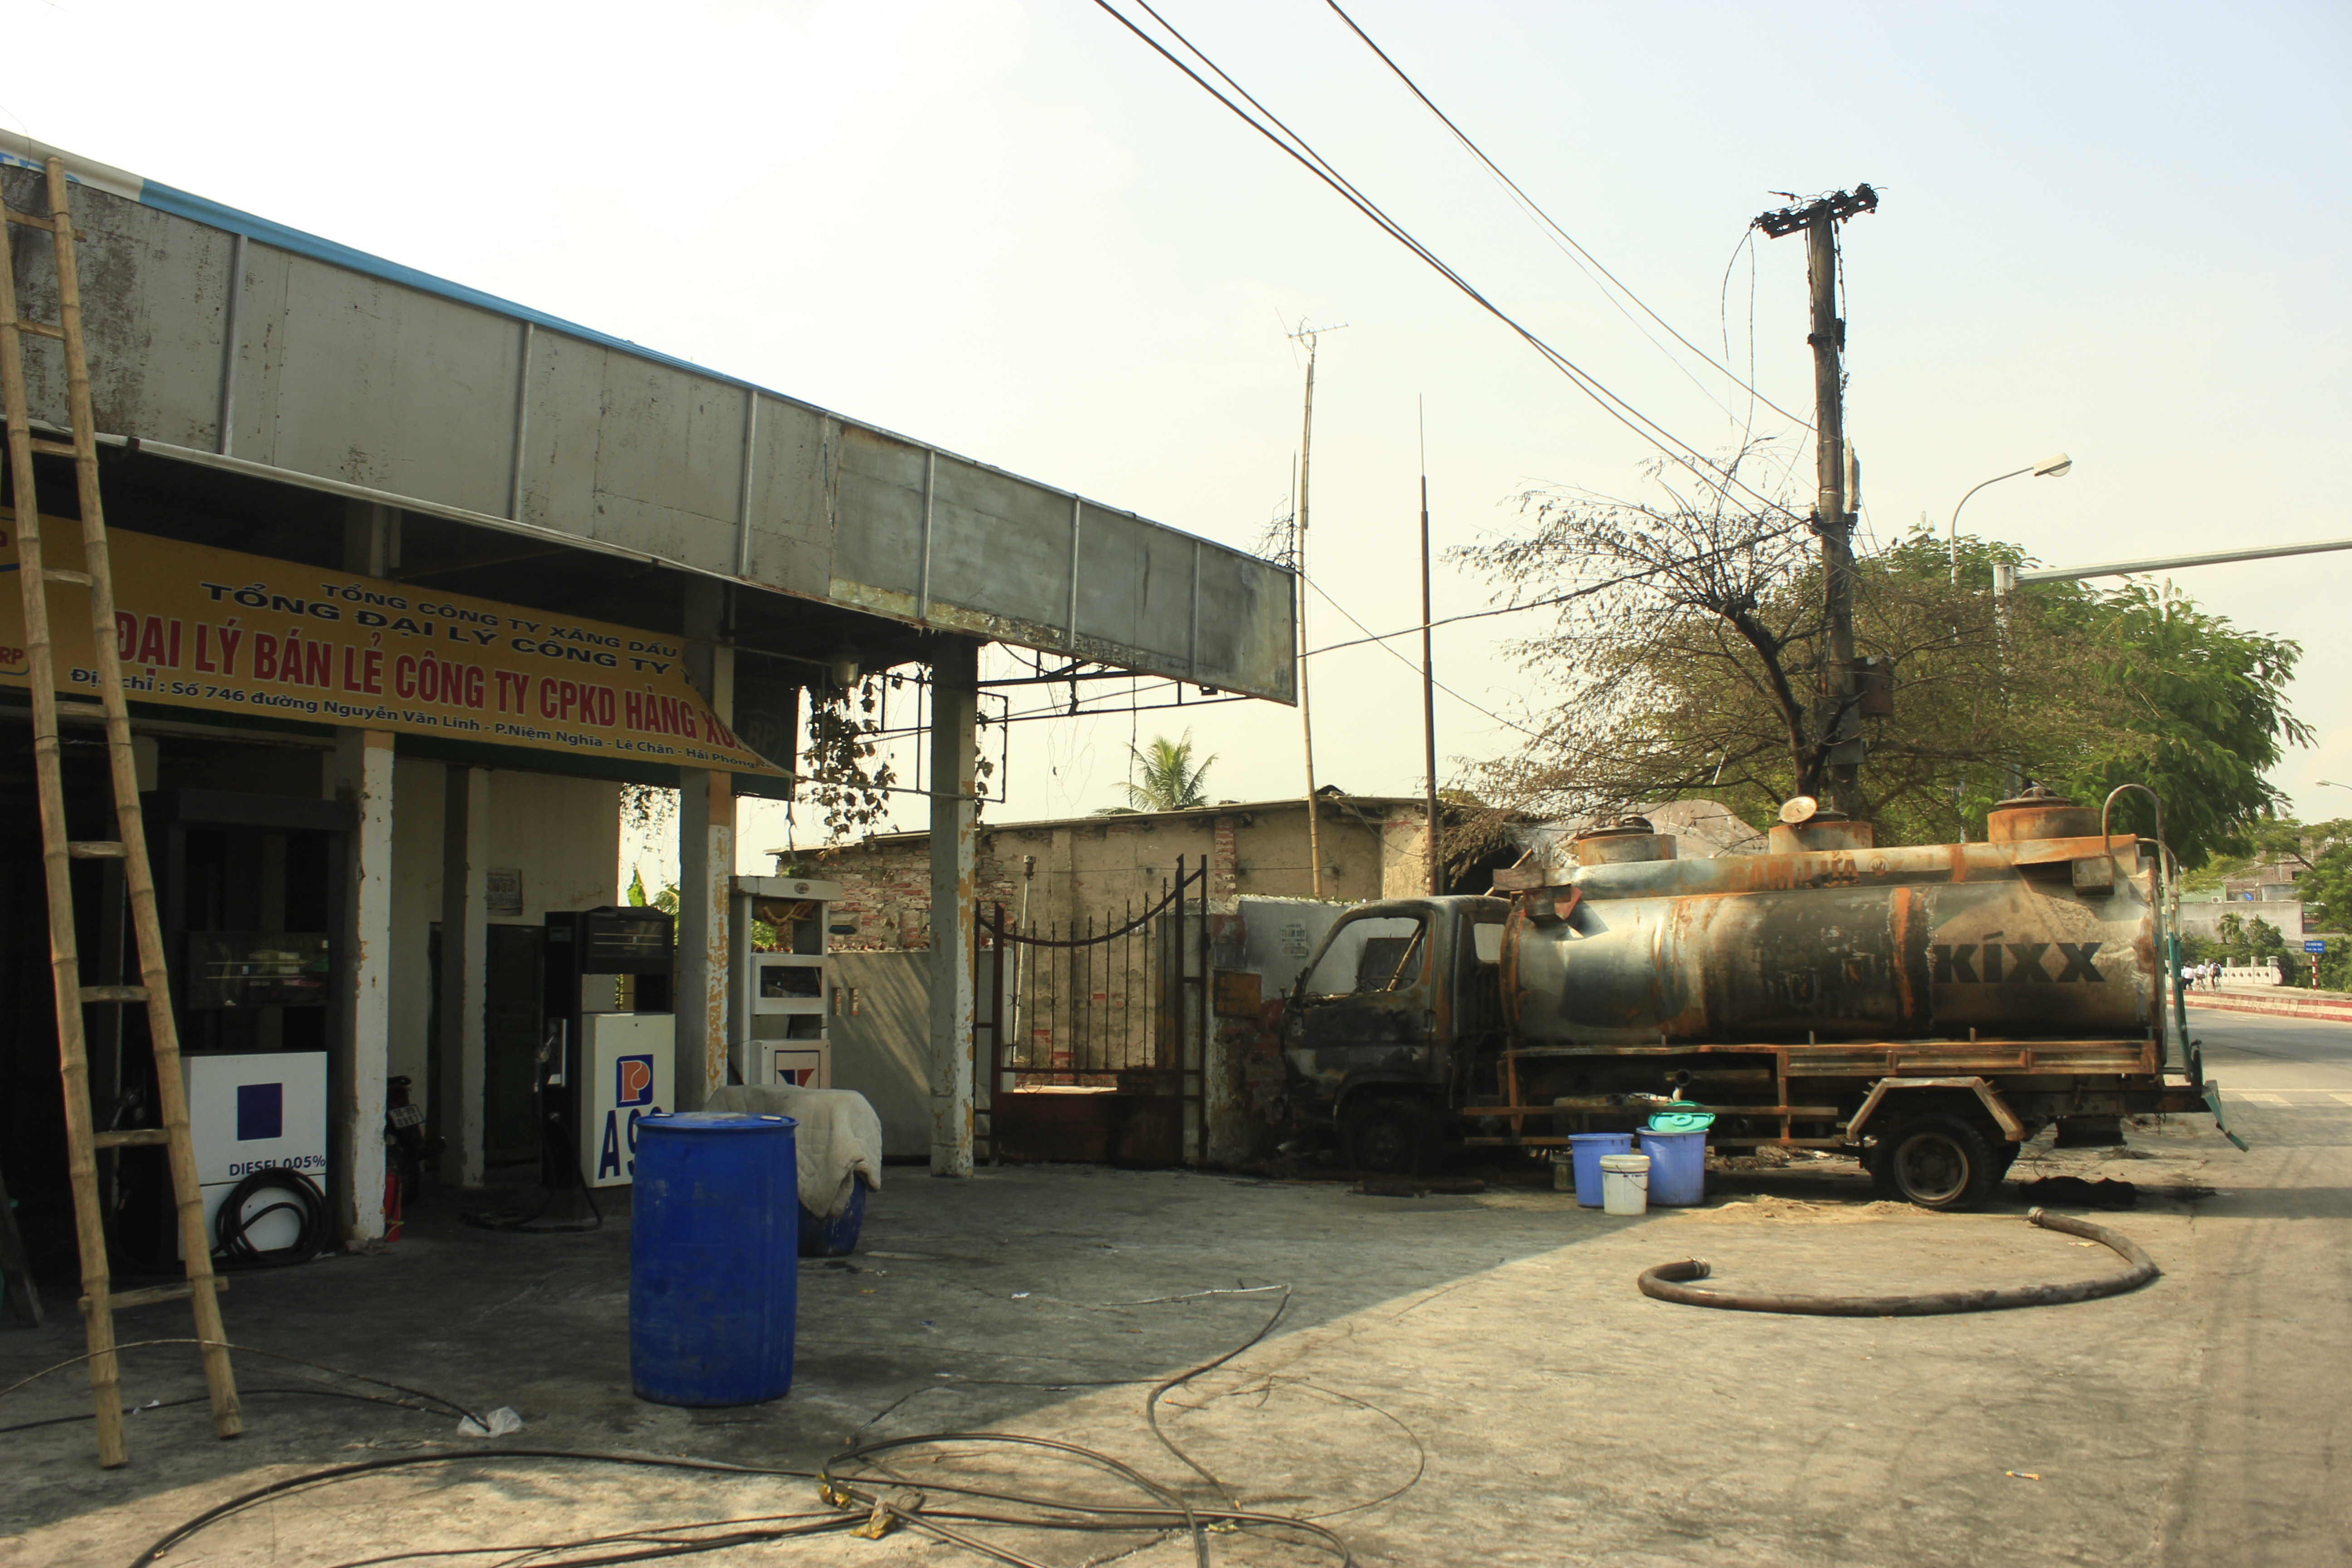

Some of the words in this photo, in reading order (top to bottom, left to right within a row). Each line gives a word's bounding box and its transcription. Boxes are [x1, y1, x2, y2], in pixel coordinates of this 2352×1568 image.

[201, 583, 341, 621] TỔNG
[355, 609, 434, 637] ĐẠI
[448, 625, 499, 646] LÝ
[511, 638, 617, 667] CÔNG
[629, 657, 671, 675] TY
[320, 583, 407, 610] TỔNG
[417, 602, 499, 627] CÔNG
[507, 617, 541, 634] TY
[549, 626, 621, 648] XĂNG
[628, 640, 678, 657] DẦU
[70, 668, 103, 687] Đị
[171, 682, 200, 697] Số
[205, 685, 246, 702] 746
[250, 691, 318, 714] đường
[323, 701, 399, 720] Nguyễn
[402, 710, 438, 727] Văn
[441, 715, 480, 731] Linh
[494, 722, 552, 741] P.Niệm
[555, 730, 603, 747] Nghĩa
[616, 738, 633, 750] Lê
[636, 741, 675, 755] Chân
[686, 746, 709, 760] Hải
[712, 752, 755, 769] Phòng
[114, 610, 182, 676] ĐẠI
[195, 617, 243, 676] LÝ
[253, 627, 333, 689] BÁN
[343, 631, 384, 696] LẺ
[395, 649, 485, 709] CÔNG
[494, 670, 531, 715] TY
[539, 677, 616, 727] CPKD
[624, 684, 698, 740] HÀNG
[699, 710, 744, 749] XU
[746, 720, 778, 752] BP
